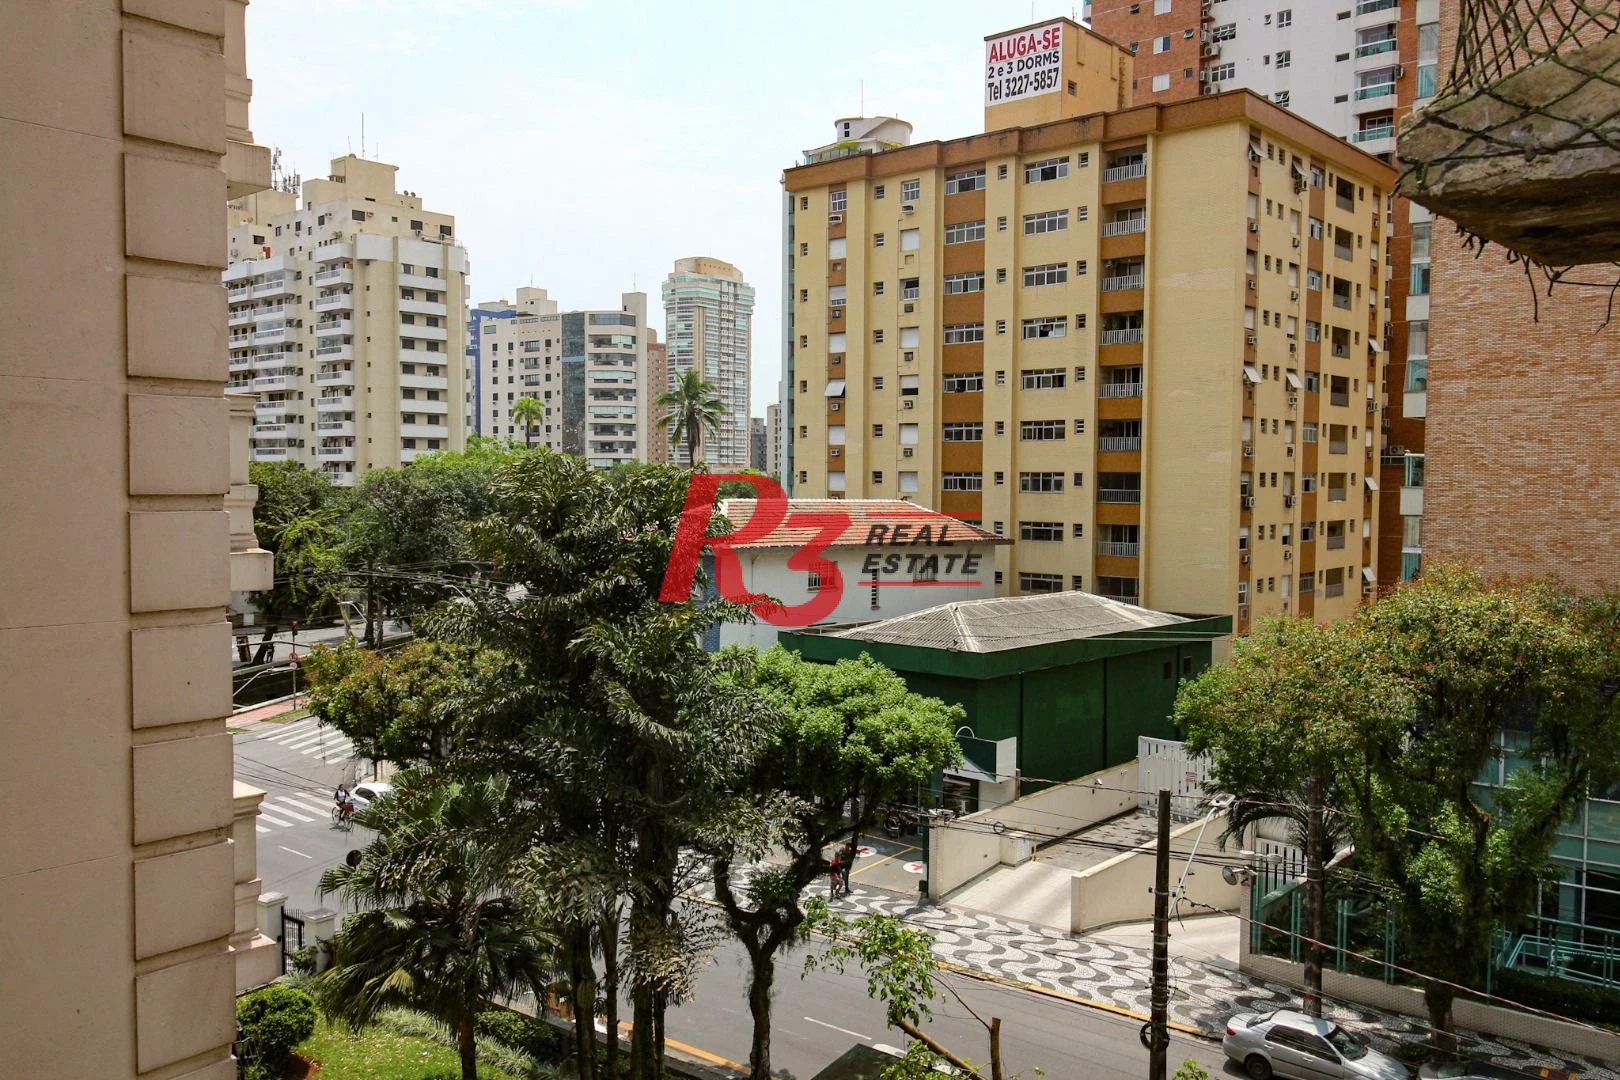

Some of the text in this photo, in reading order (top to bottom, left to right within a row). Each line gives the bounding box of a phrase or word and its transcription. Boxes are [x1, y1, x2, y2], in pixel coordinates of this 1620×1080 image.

[989, 27, 1060, 63] ALUGA-SE
[988, 51, 1059, 79] 2 e 3 DORMS
[988, 68, 1059, 101] Tel 3227-5857
